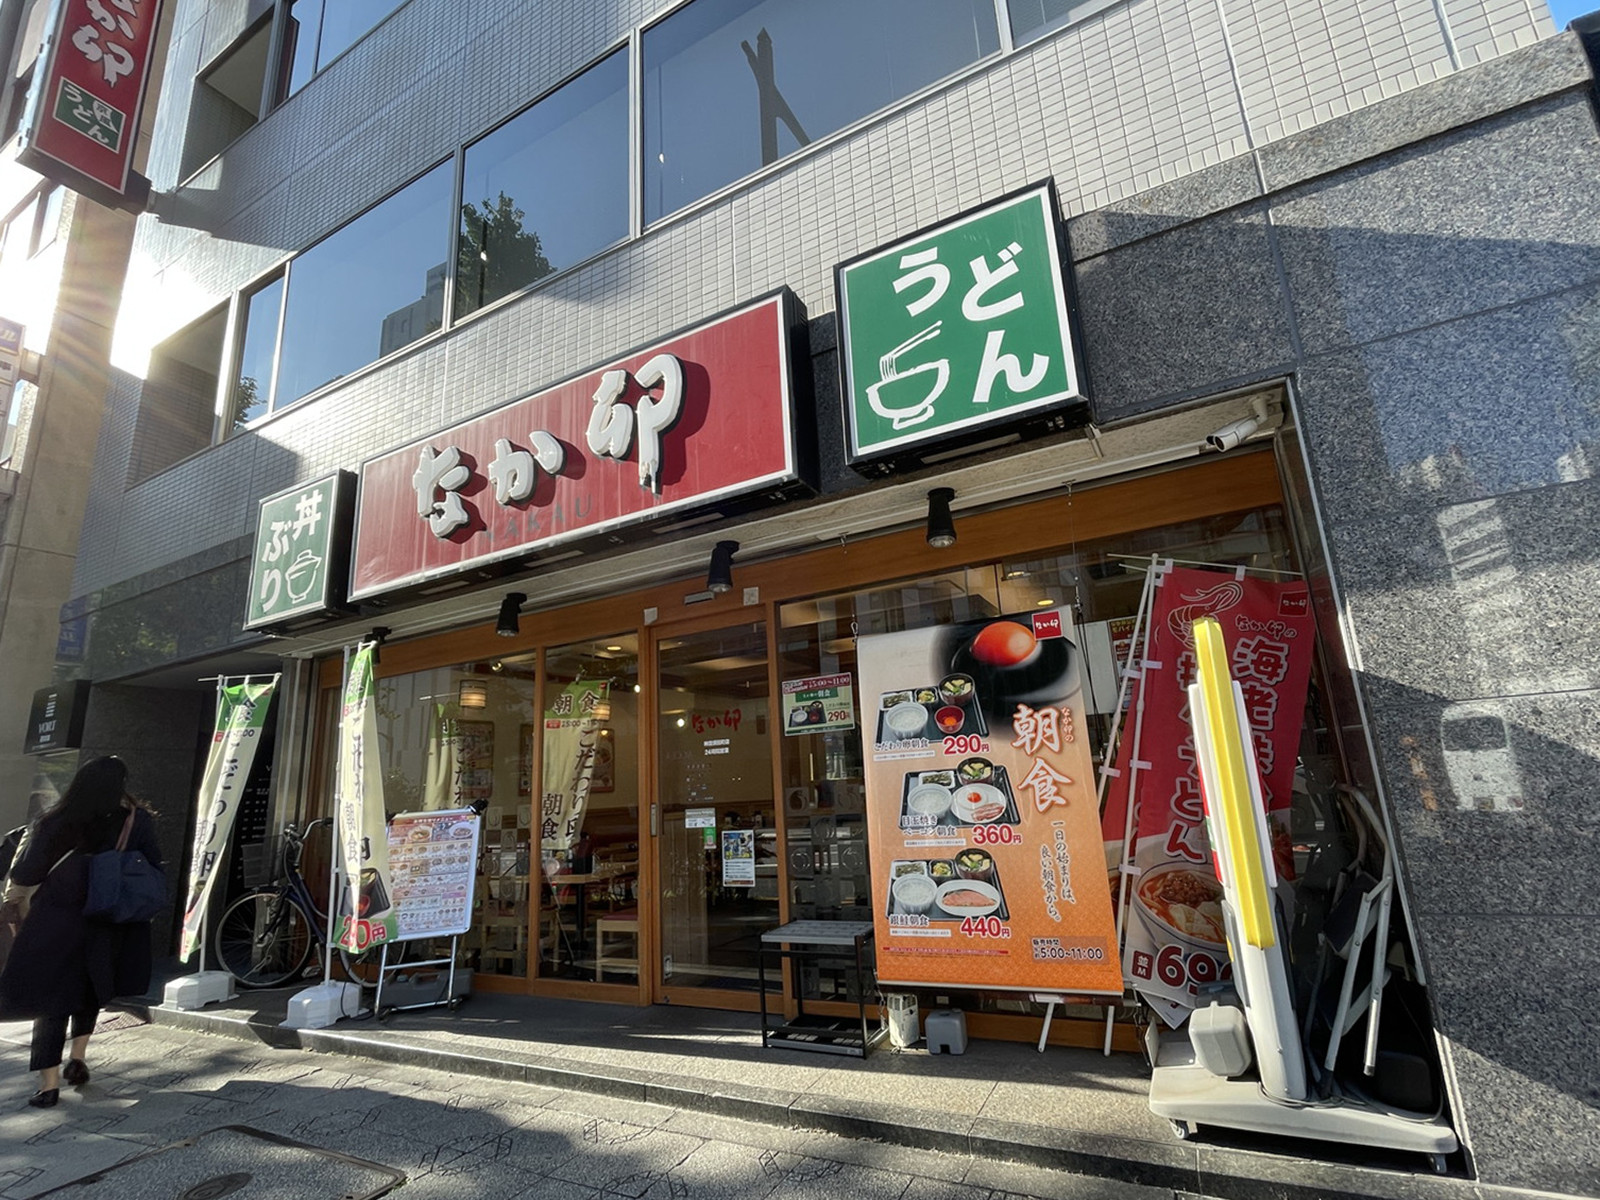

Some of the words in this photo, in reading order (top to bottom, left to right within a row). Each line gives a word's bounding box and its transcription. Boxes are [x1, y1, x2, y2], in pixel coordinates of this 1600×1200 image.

[63, 84, 110, 144] うどん
[892, 241, 1049, 402] うどん
[412, 353, 684, 540] なか卵
[261, 489, 323, 613] 丼ぶり
[1235, 614, 1298, 642] なか卵の
[553, 690, 600, 715] 朝食
[692, 708, 742, 734] なか卵
[943, 734, 990, 755] 290円
[1061, 706, 1075, 743] なか卵の
[1010, 704, 1073, 813] 朝食
[541, 793, 563, 842] 朝食
[972, 825, 1022, 845] 360円
[1040, 844, 1062, 922] 良い朝食から。
[1051, 820, 1076, 904] 一日の始まりは、
[960, 916, 1011, 938] 440円
[1137, 967, 1147, 978] M
